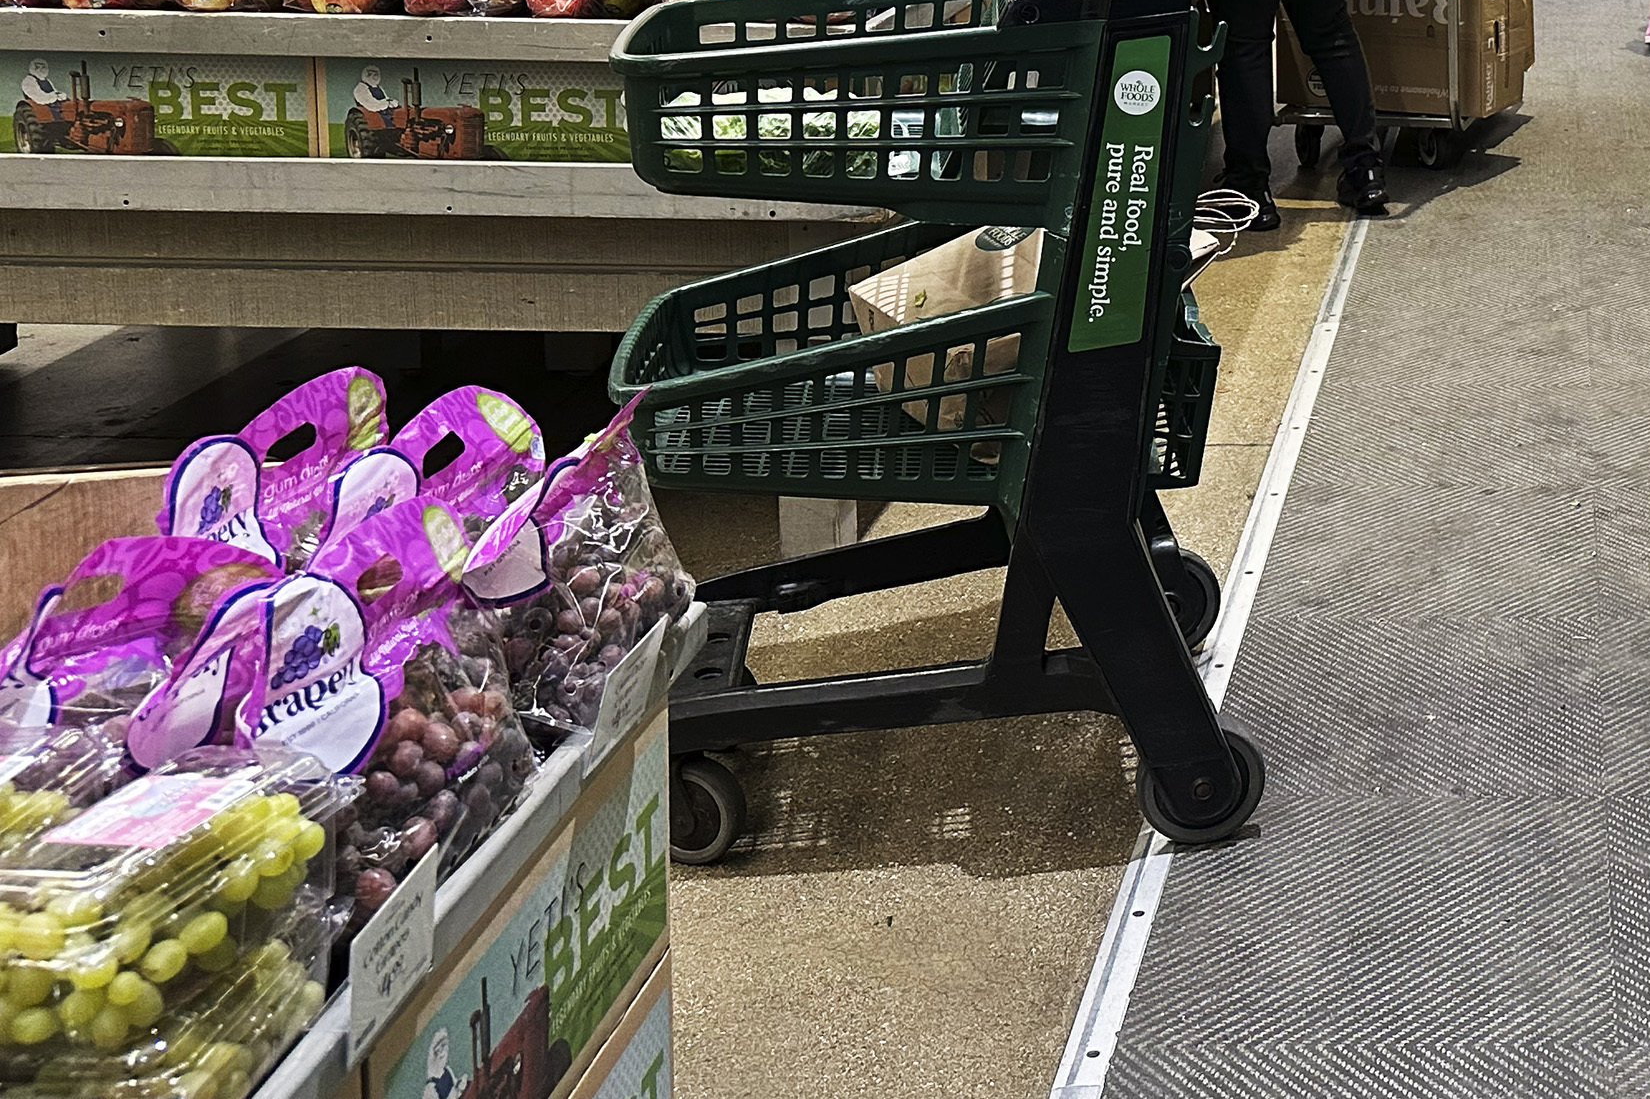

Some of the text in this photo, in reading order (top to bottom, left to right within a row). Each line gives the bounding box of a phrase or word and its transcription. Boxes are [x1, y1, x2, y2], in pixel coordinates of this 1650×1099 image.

[110, 65, 198, 89] YETI'S
[442, 72, 528, 96] YETI'S
[1120, 82, 1156, 93] WHOLE
[149, 81, 298, 121] BEST
[478, 88, 624, 128] BEST
[1121, 91, 1154, 103] FOODS
[158, 126, 285, 136] LEGENDARY FRUITS & VEGETABLES
[488, 132, 614, 143] LEGENDARY FRUITS & VEGETABLES
[1118, 145, 1155, 253] Real food,
[1087, 142, 1125, 323] pure and simple.
[264, 477, 298, 502] gum
[544, 793, 659, 994] BEST
[510, 861, 586, 996] YETI'S
